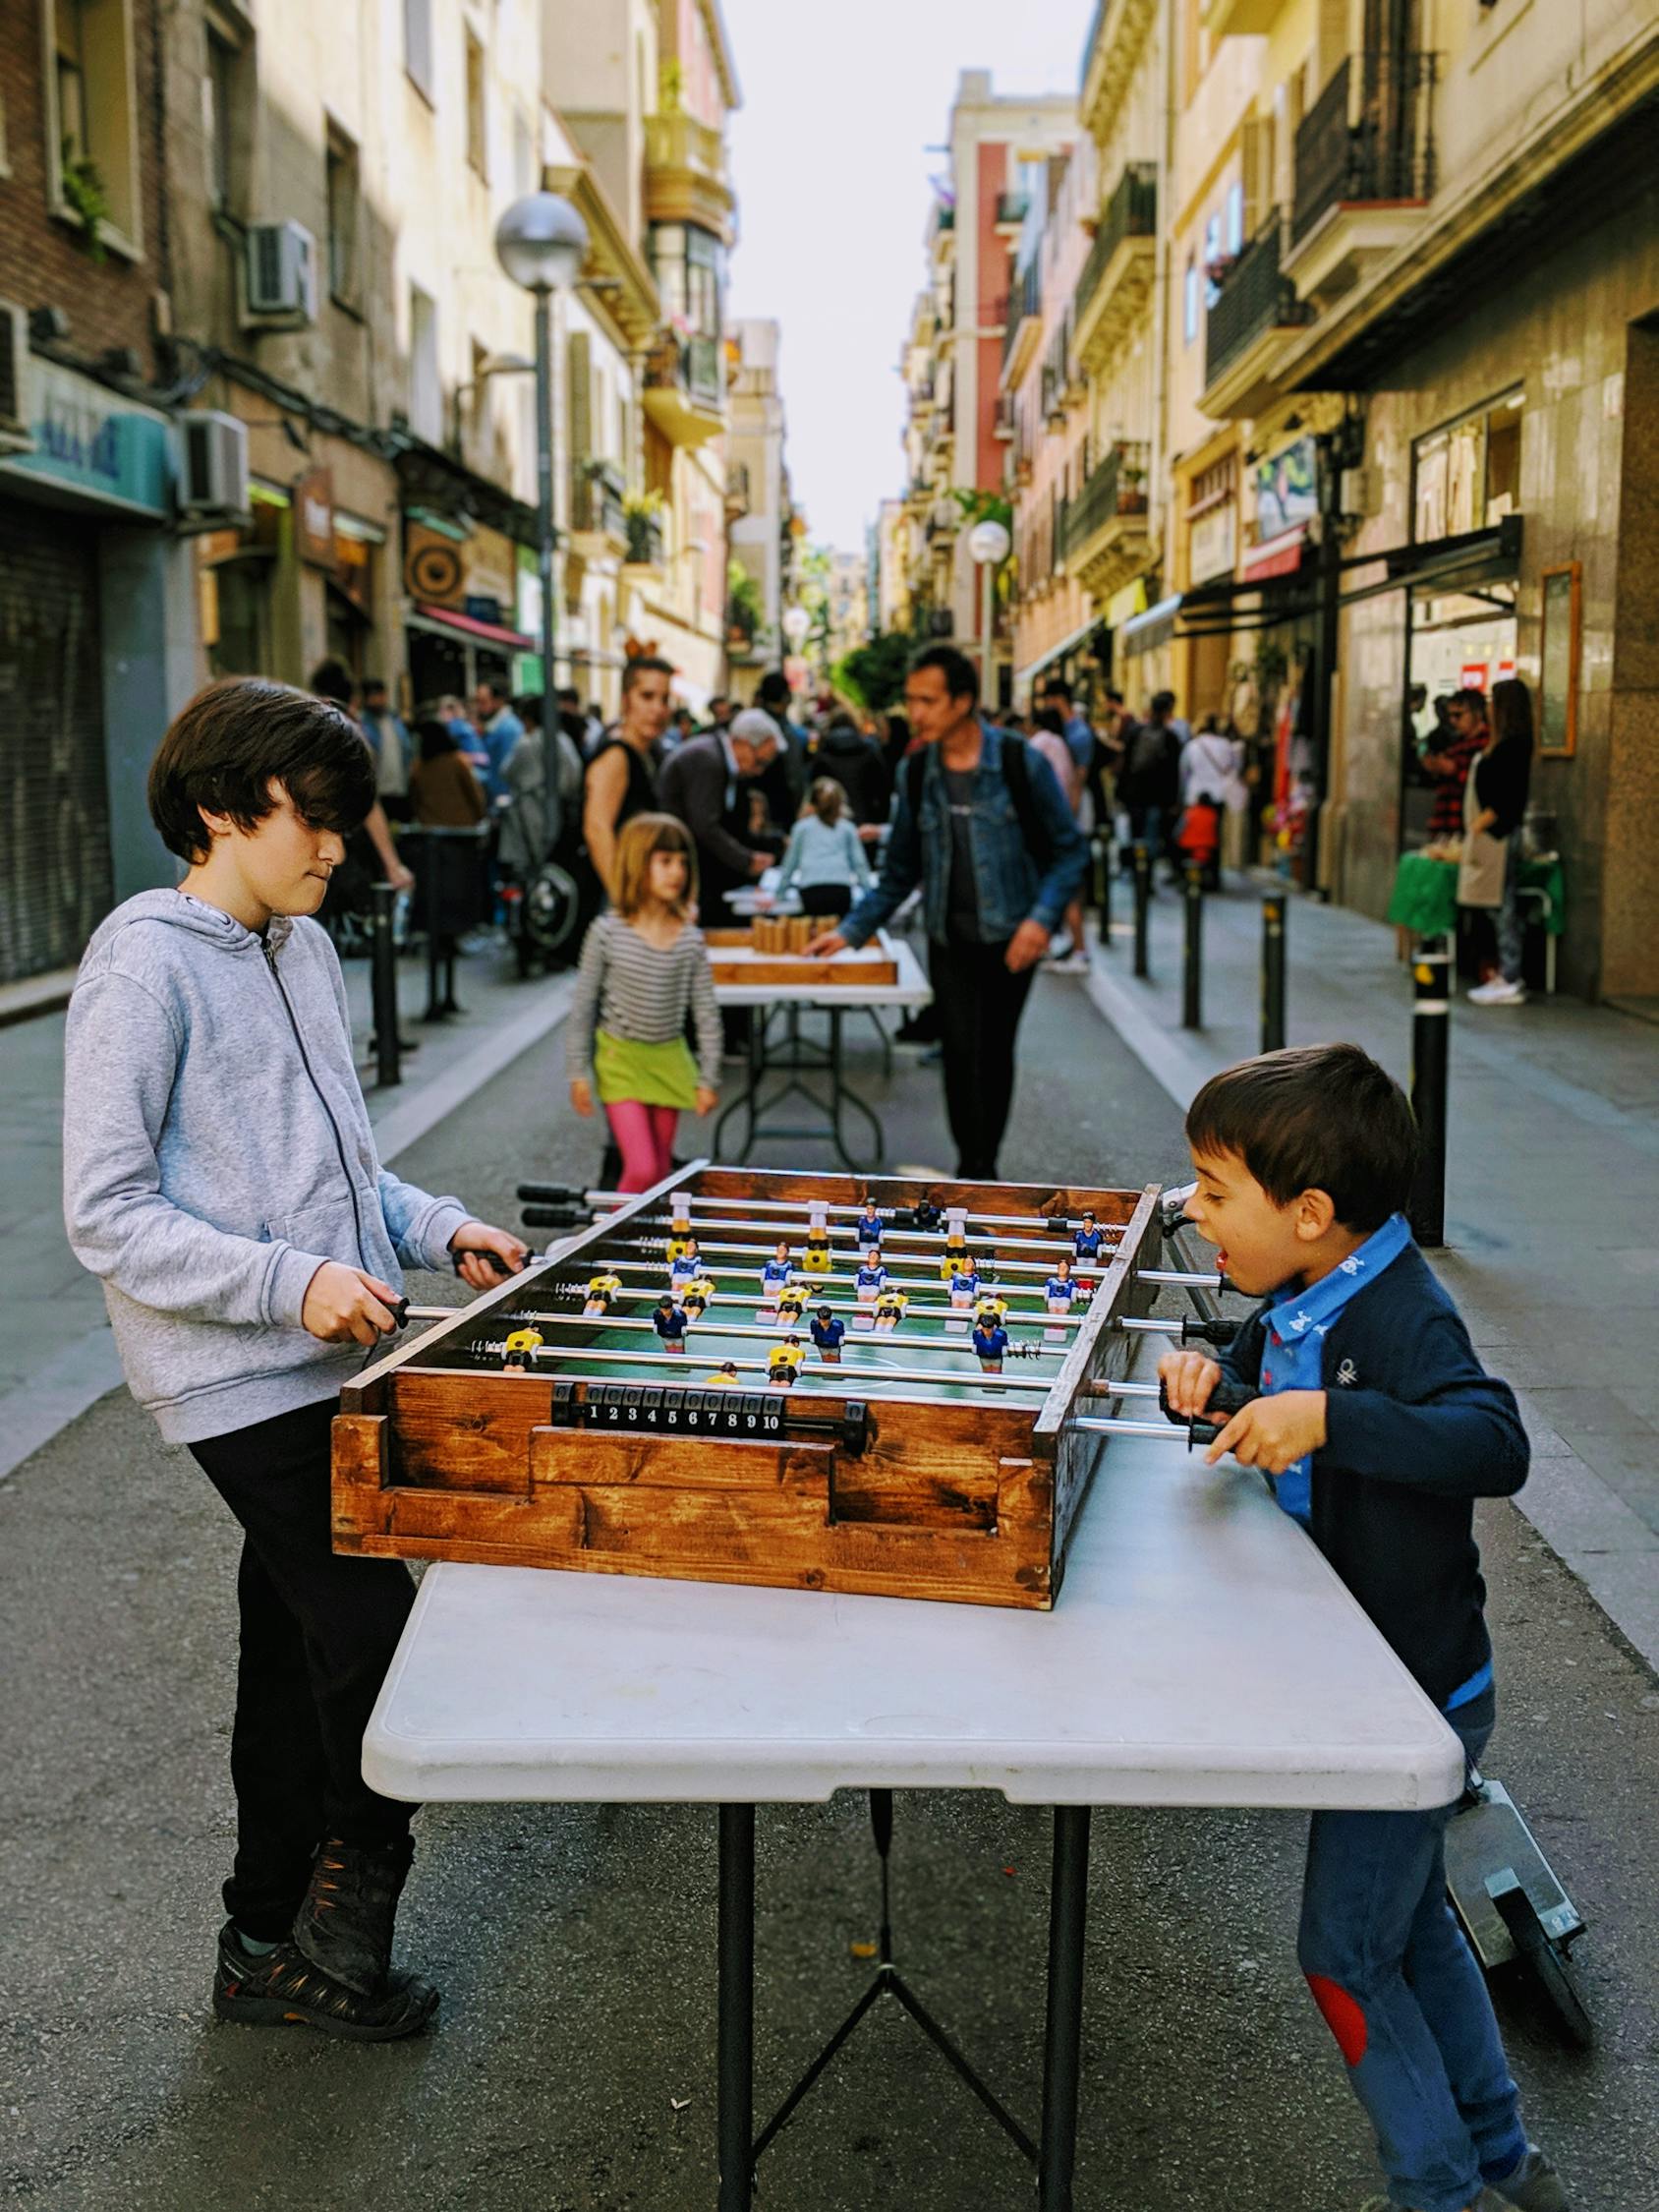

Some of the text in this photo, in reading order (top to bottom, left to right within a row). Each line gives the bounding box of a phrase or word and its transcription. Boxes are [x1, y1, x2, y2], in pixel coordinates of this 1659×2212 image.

[608, 1407, 618, 1421] 2
[628, 1408, 638, 1421] 3
[647, 1410, 657, 1423] 4
[667, 1411, 677, 1424] 5
[688, 1412, 698, 1426] 6
[708, 1413, 717, 1426] 7
[727, 1414, 737, 1426] 8
[747, 1415, 757, 1428] 9
[763, 1416, 779, 1429] 10
